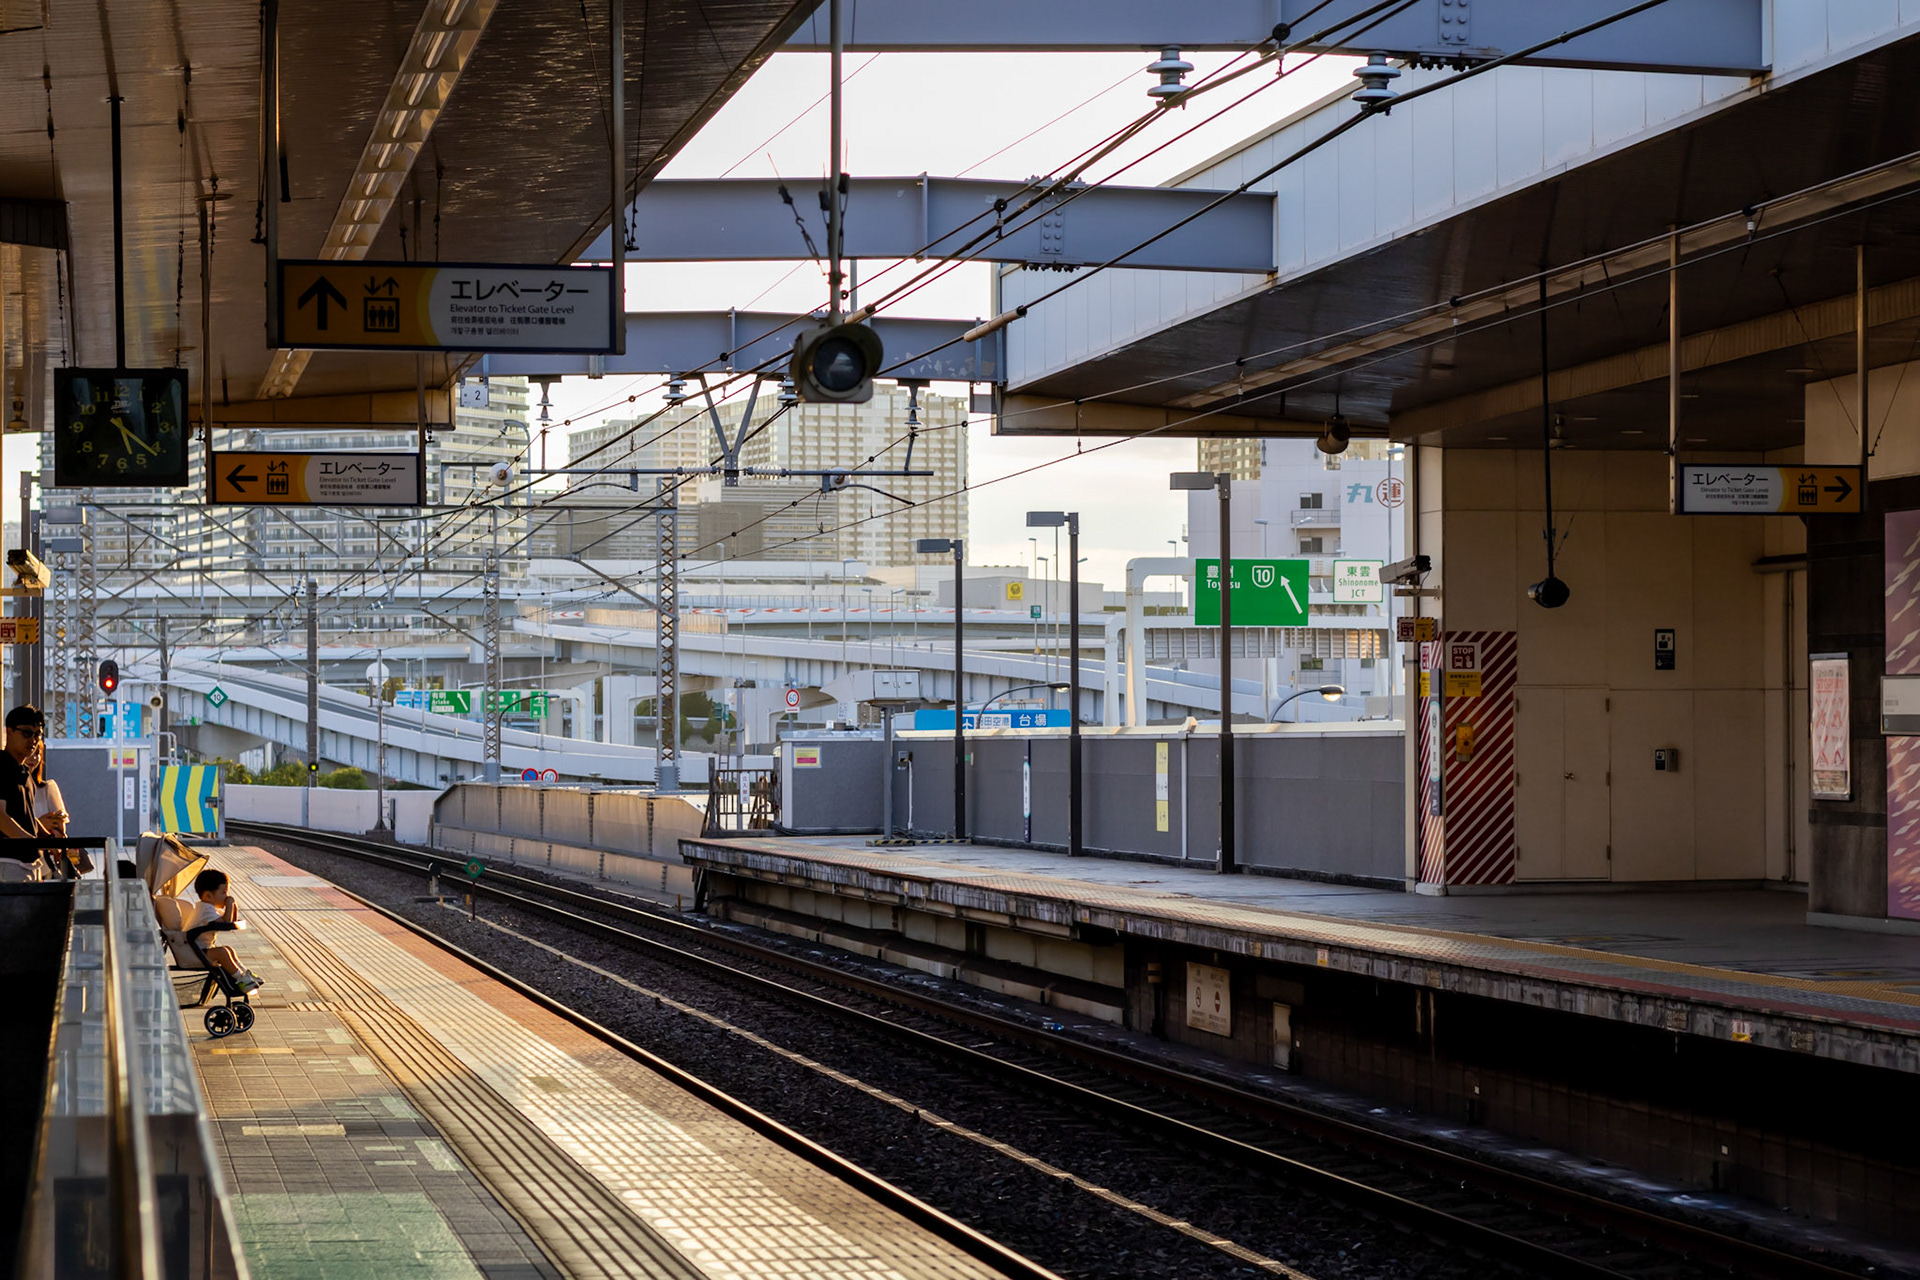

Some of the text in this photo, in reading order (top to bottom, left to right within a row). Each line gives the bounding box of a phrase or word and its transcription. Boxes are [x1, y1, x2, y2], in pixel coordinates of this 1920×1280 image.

[450, 279, 589, 302] エレベーター
[450, 304, 575, 315] Elevator to Ticket Gate Level
[113, 386, 130, 397] 12
[475, 389, 481, 401] 2
[80, 404, 96, 416] 10
[151, 402, 162, 413] 2
[73, 421, 85, 433] 9
[159, 421, 171, 433] 3
[82, 440, 93, 453] 8
[98, 454, 110, 466] 7
[116, 458, 128, 470] 6
[136, 454, 147, 465] 5
[319, 462, 406, 476] エレベーター
[1692, 473, 1769, 486] エレベーター
[1207, 565, 1234, 578] 豊
[1256, 569, 1271, 583] 10
[1347, 566, 1371, 577] 東雲
[1207, 580, 1241, 591] Toysu
[1338, 578, 1379, 587] Shinonome
[1351, 589, 1366, 599] JCT
[1453, 647, 1474, 655] STOP
[213, 693, 222, 702] 10
[432, 692, 447, 700] 有明
[788, 694, 797, 703] 60
[1019, 714, 1047, 727] 台場
[544, 773, 555, 783] 60
